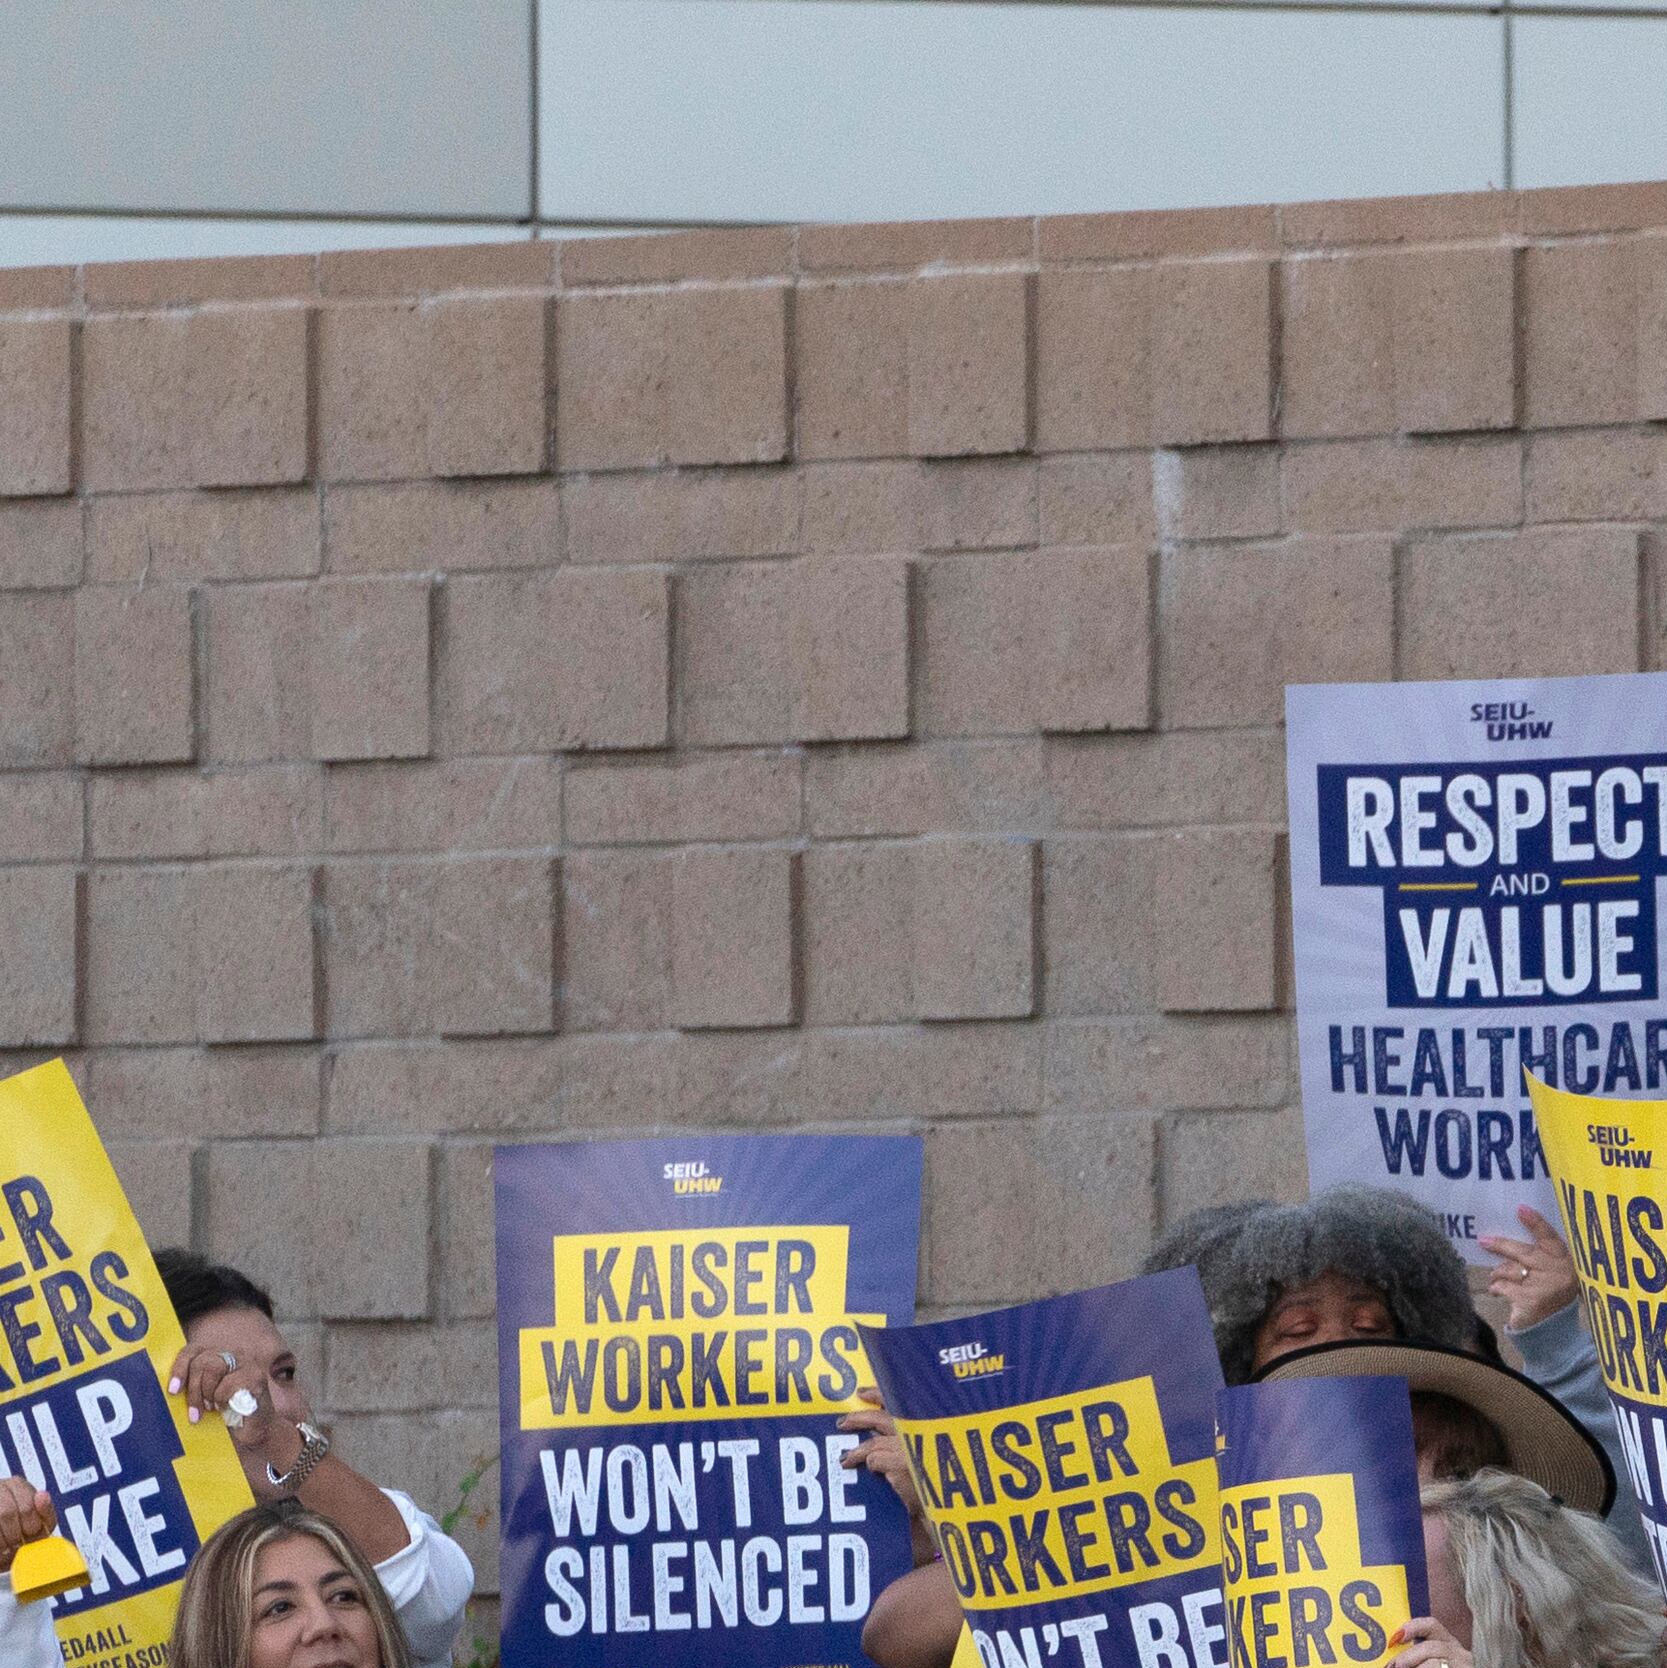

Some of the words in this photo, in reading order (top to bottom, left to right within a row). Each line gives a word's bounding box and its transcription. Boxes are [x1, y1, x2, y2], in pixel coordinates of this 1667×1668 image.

[1470, 703, 1535, 722] SEIU-
[1486, 721, 1553, 741] UHW
[1490, 874, 1550, 896] AND
[1399, 901, 1642, 998] VALUE
[1374, 1106, 1551, 1180] WORK
[1587, 1124, 1635, 1147] SEIU-
[1600, 1146, 1652, 1169] UHW
[674, 1177, 722, 1194] UHW
[584, 1239, 816, 1324] KAISER
[541, 1325, 859, 1415] WORKERS
[939, 1342, 988, 1365] SEIU-
[953, 1354, 1004, 1379] UHW
[904, 1401, 1132, 1510] KAISER
[540, 1441, 760, 1537] WON'T
[779, 1434, 867, 1526] BE
[932, 1477, 1206, 1602] ORKERS
[1221, 1492, 1324, 1582] SER
[544, 1533, 871, 1637] SILENCED
[61, 1624, 131, 1661] ED4ALL
